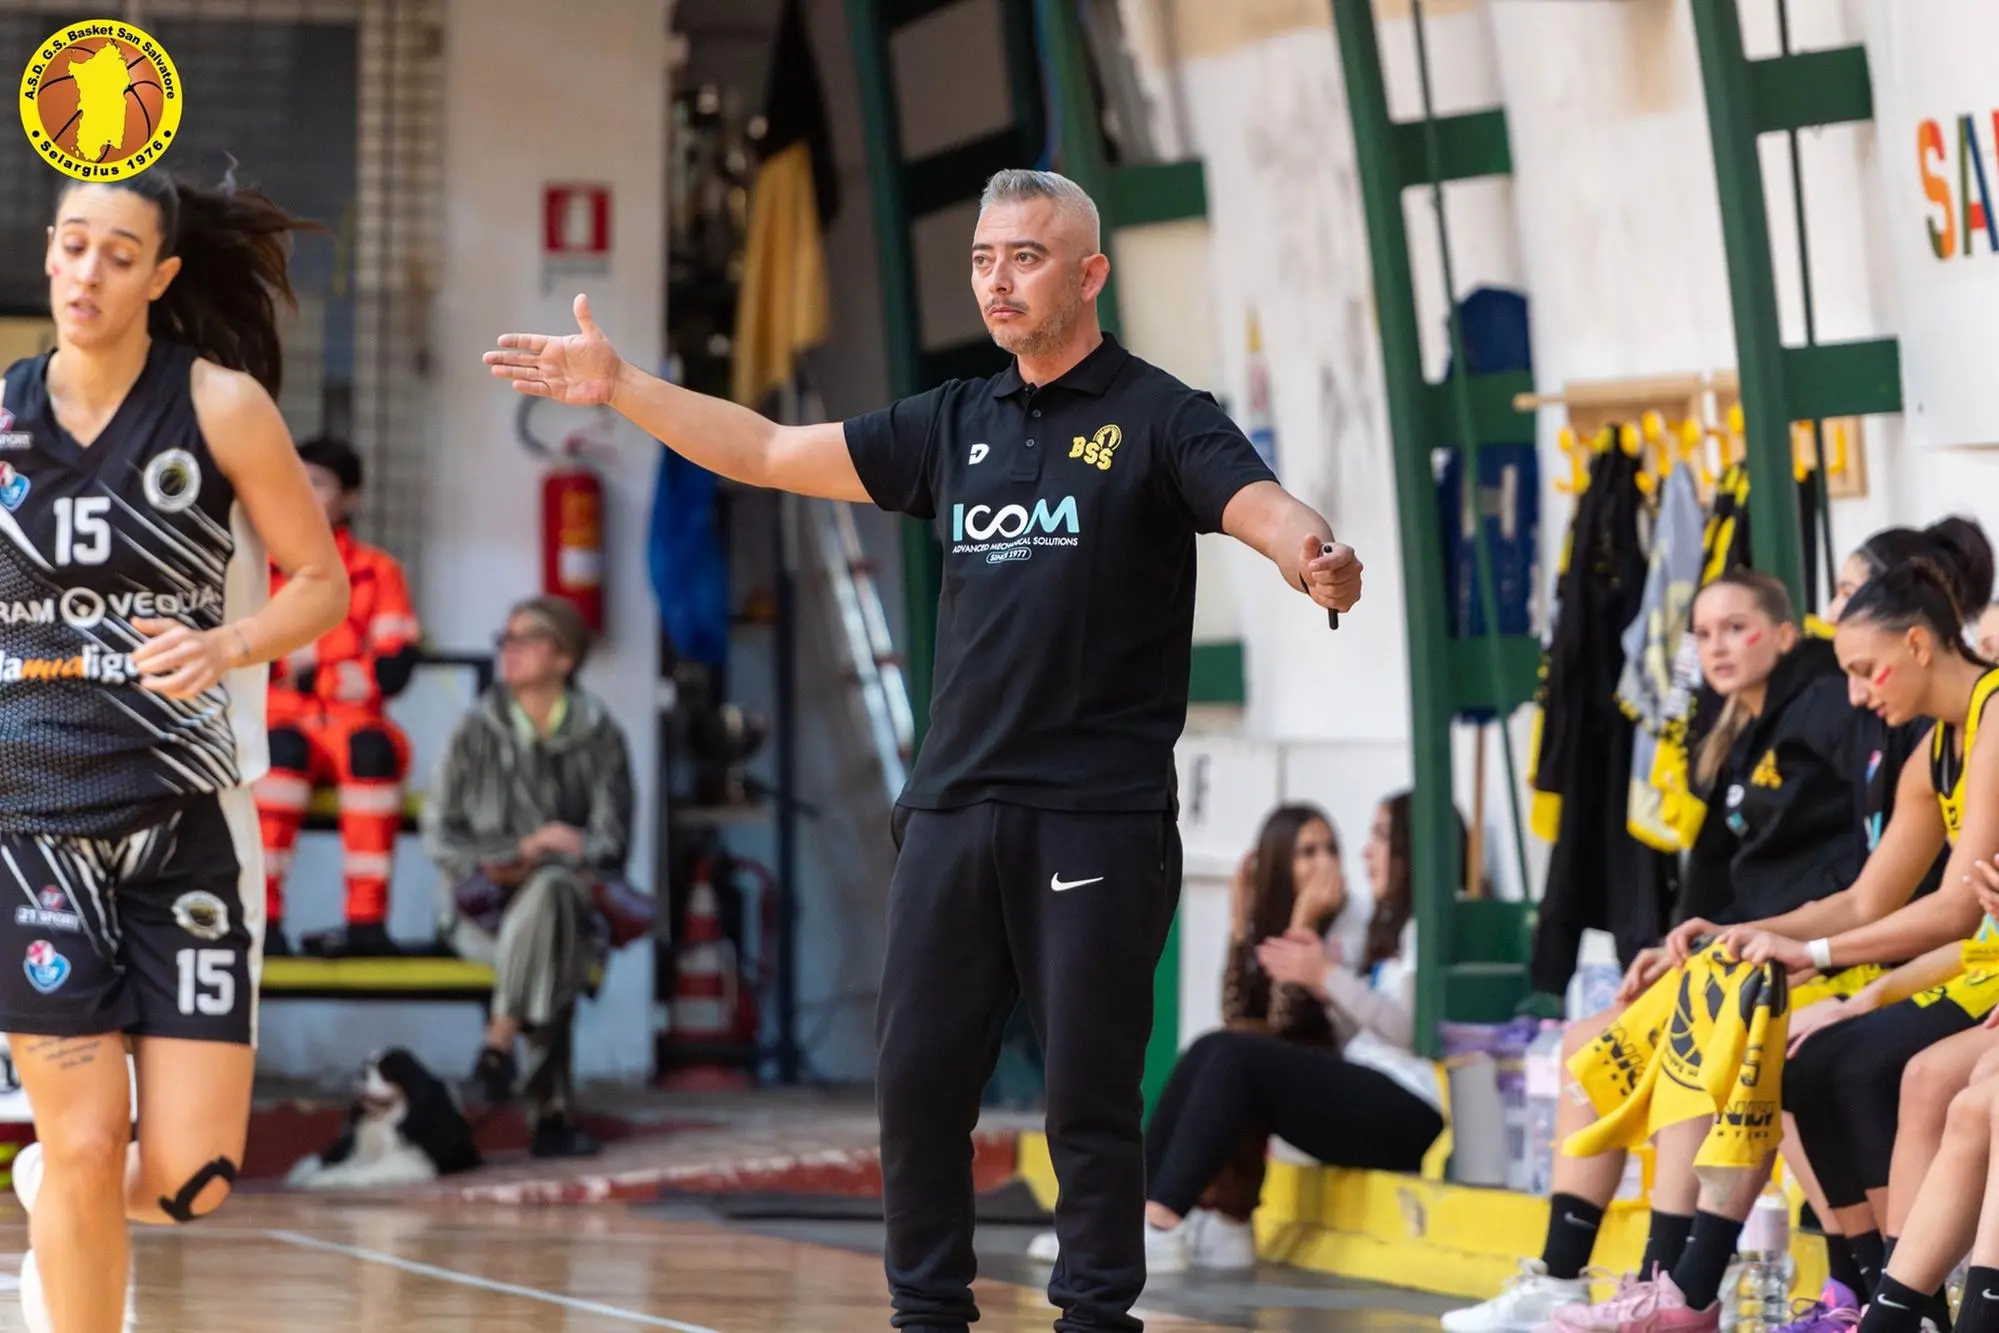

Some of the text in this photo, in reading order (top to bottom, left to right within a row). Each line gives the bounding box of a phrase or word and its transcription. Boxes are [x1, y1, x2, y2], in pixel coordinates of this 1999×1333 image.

[1916, 110, 1999, 262] SA
[53, 496, 111, 566] 15
[952, 544, 989, 554] ADVANCED
[1033, 536, 1079, 546] SOLUTIONS
[953, 495, 1080, 542] ICOM
[1009, 550, 1027, 559] 1977
[176, 948, 236, 1016] 15
